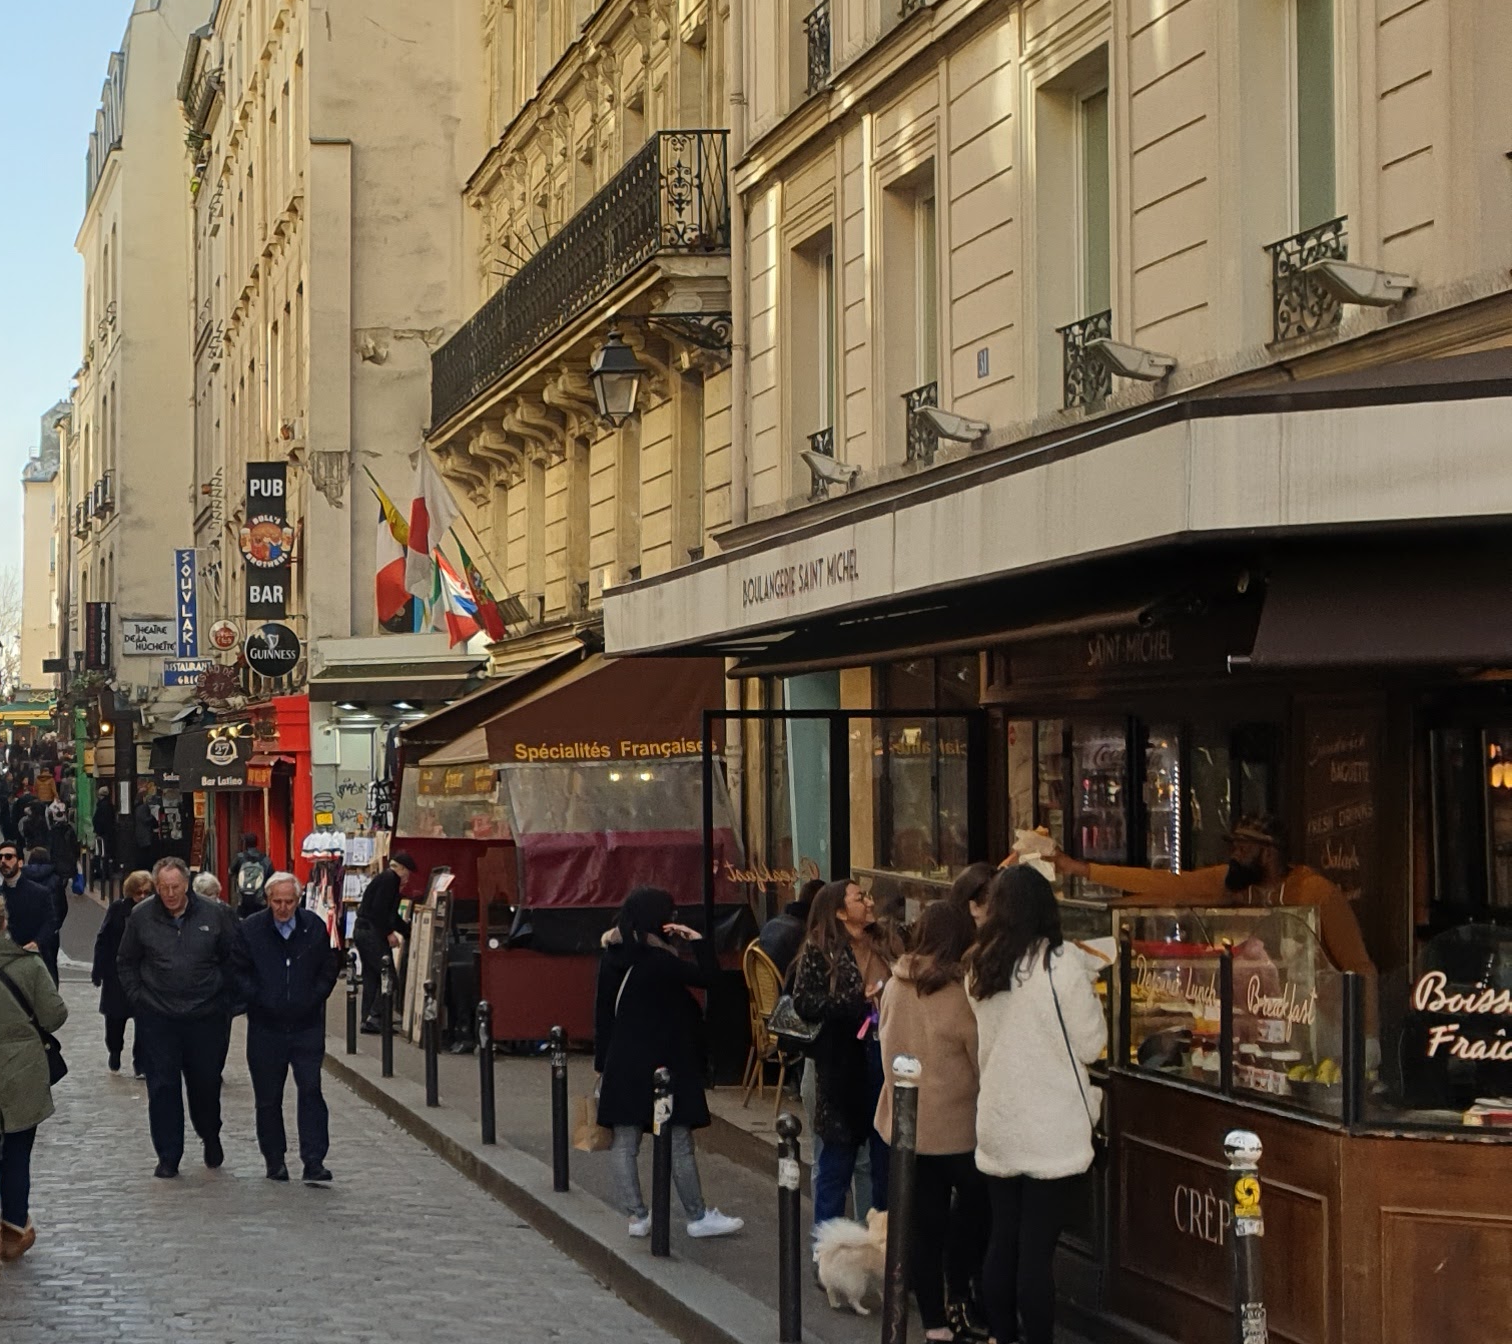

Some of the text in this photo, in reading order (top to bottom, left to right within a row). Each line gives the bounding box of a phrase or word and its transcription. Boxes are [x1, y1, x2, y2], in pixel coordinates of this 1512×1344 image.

[250, 479, 284, 497] PUB
[742, 547, 859, 609] BOULANGERIE SAINT MICHEL
[180, 551, 194, 656] SOUVLAKI
[249, 585, 284, 604] BAR
[124, 634, 147, 642] DE LA
[136, 641, 176, 650] HUCHETTE
[249, 647, 297, 660] GUINNESS
[514, 737, 718, 762] Spécialités Françaises
[201, 776, 216, 786] Bar
[218, 775, 243, 787] Latino
[1185, 966, 1218, 1007] Lunch
[1247, 974, 1318, 1043] Breakfast
